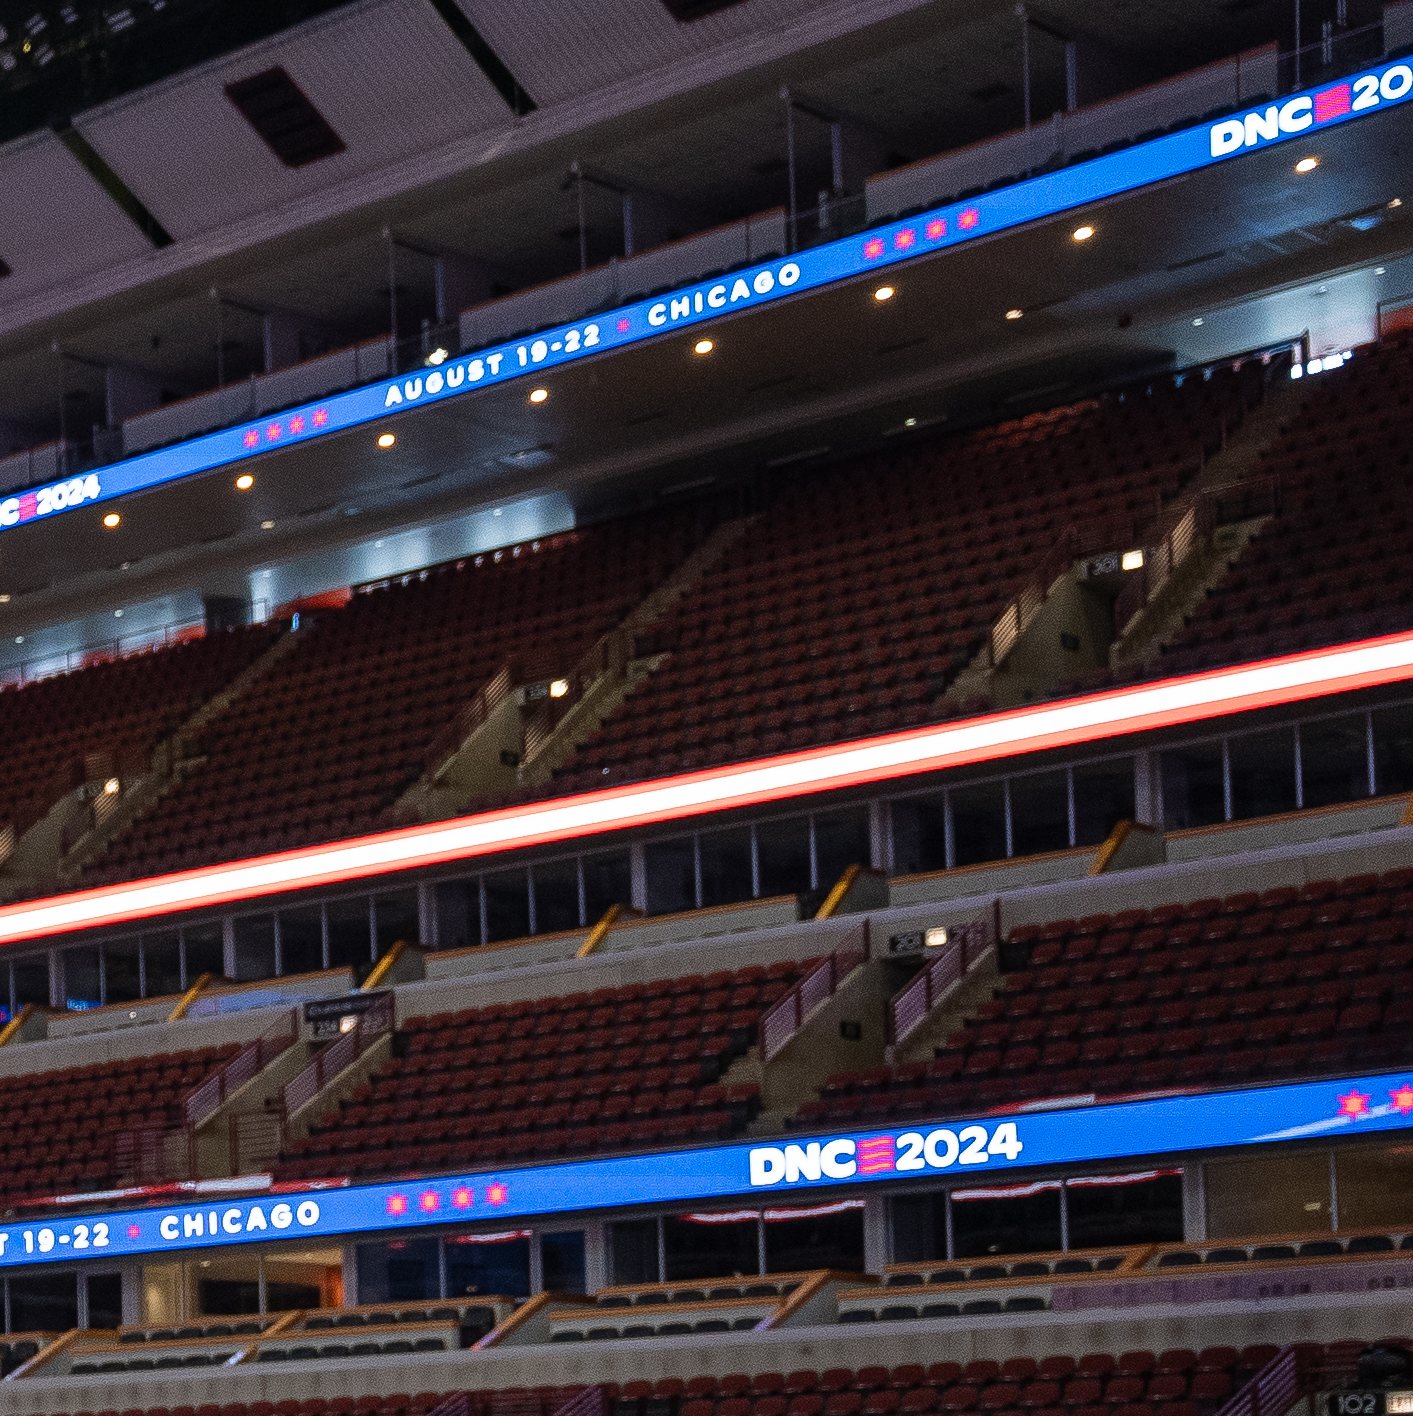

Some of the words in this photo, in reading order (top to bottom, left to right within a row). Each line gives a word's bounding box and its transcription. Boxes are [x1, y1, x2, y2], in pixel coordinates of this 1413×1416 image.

[1209, 96, 1313, 158] DNC
[384, 354, 504, 406] AUGUST
[516, 324, 601, 366] 19-22
[648, 263, 801, 327] CHICAGO
[38, 474, 102, 515] 2024
[748, 1138, 857, 1187] DNC
[895, 1122, 1023, 1171] 2024
[22, 1222, 111, 1255] 19-22
[159, 1200, 321, 1241] CHICAGO
[1337, 1393, 1377, 1415] 102
